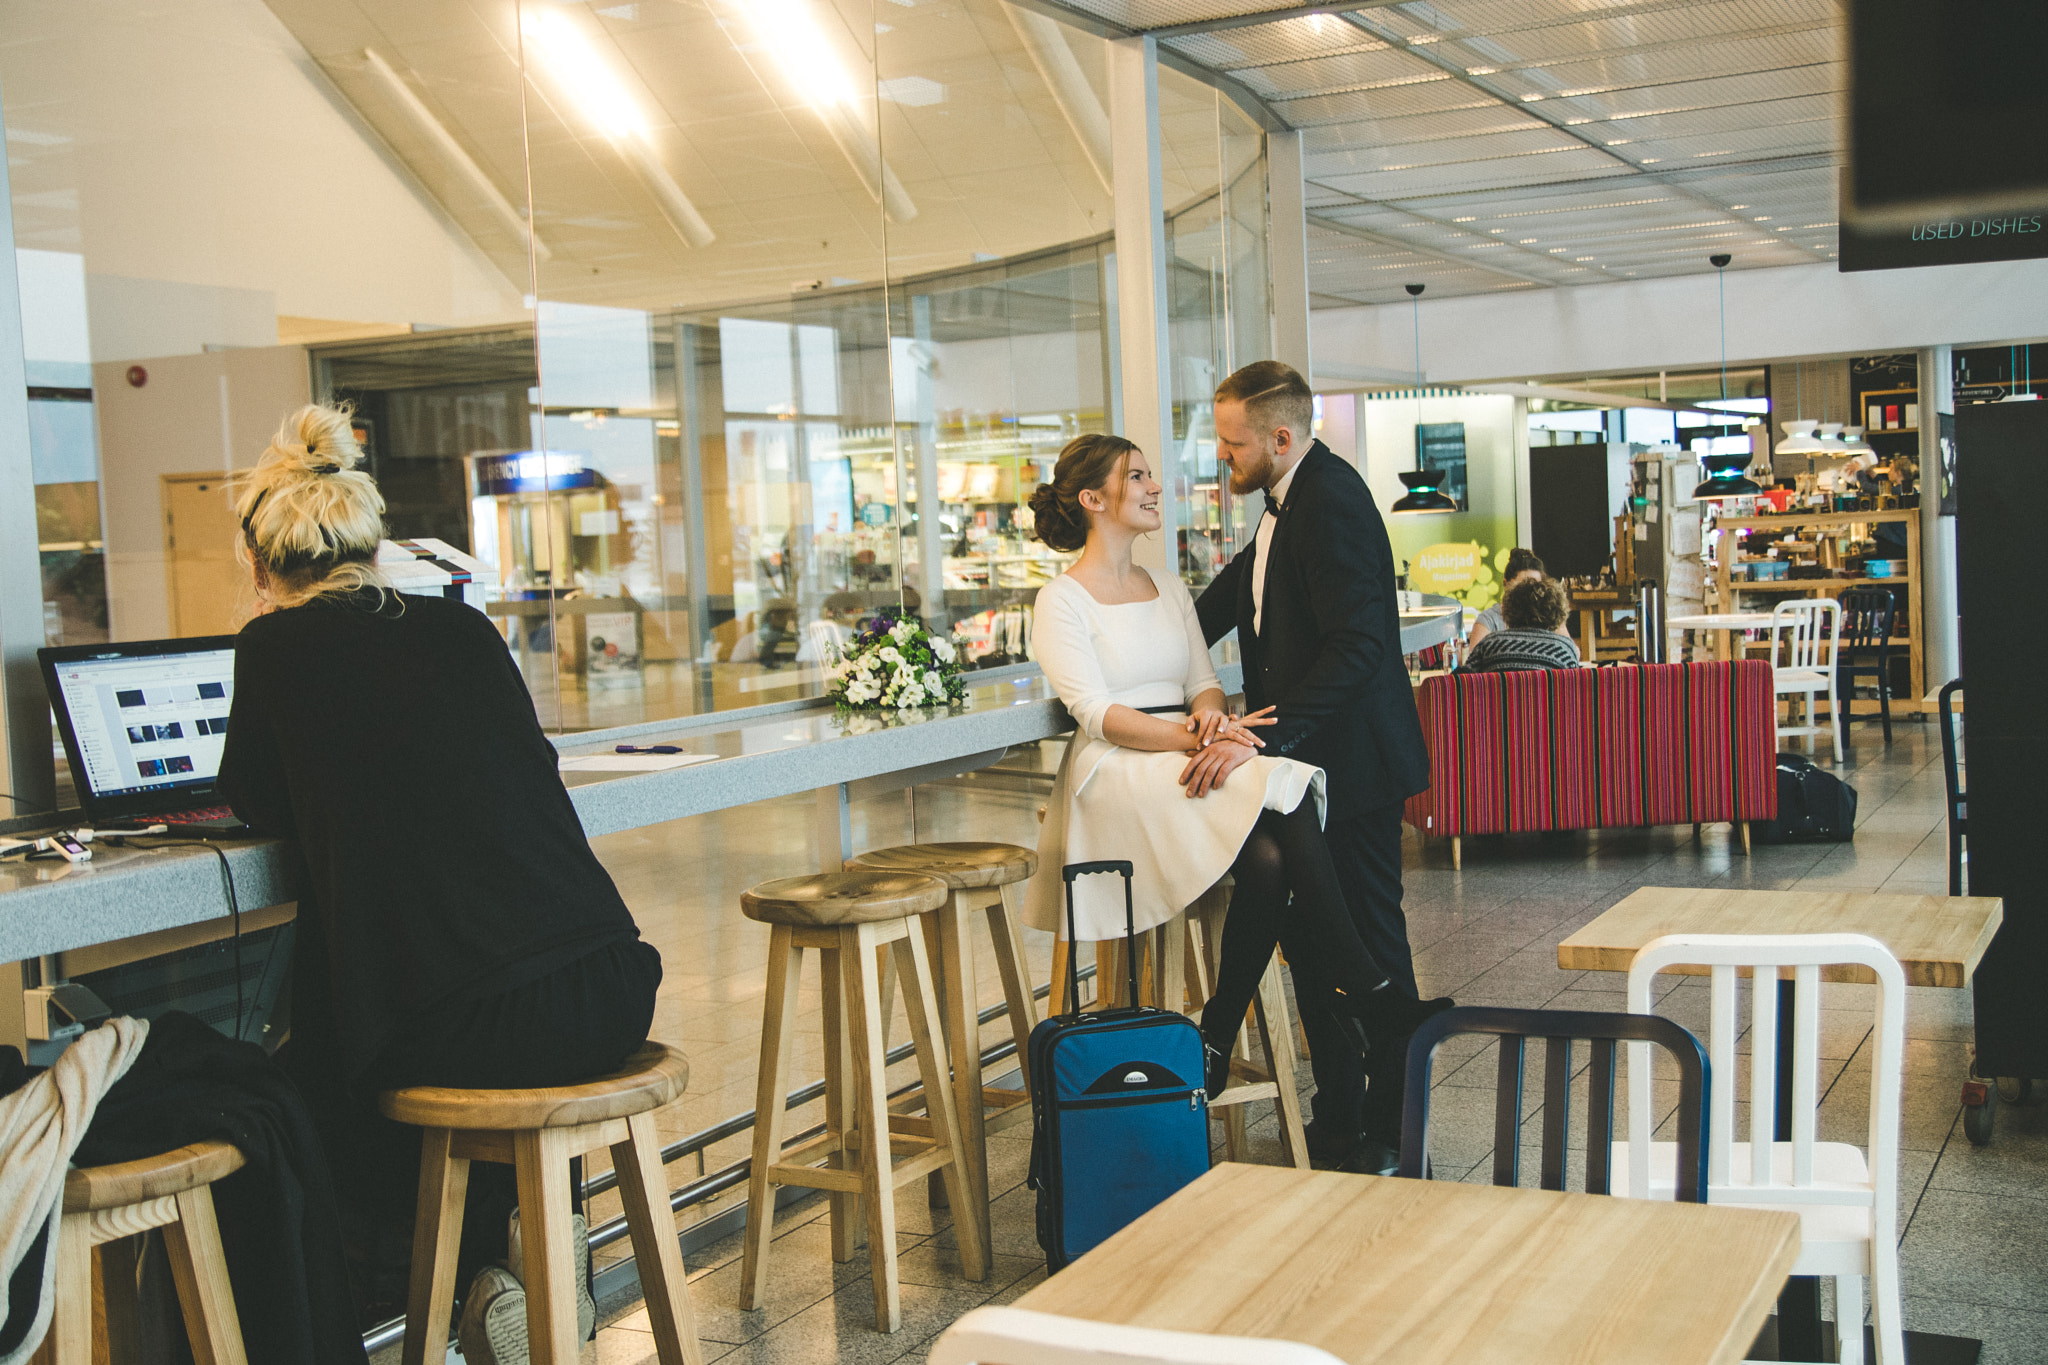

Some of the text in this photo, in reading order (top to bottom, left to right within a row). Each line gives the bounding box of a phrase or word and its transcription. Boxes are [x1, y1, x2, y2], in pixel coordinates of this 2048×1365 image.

[1912, 215, 2042, 241] USED DISHES
[1419, 552, 1474, 572] Ajakirjad
[1432, 572, 1471, 583] Magazines
